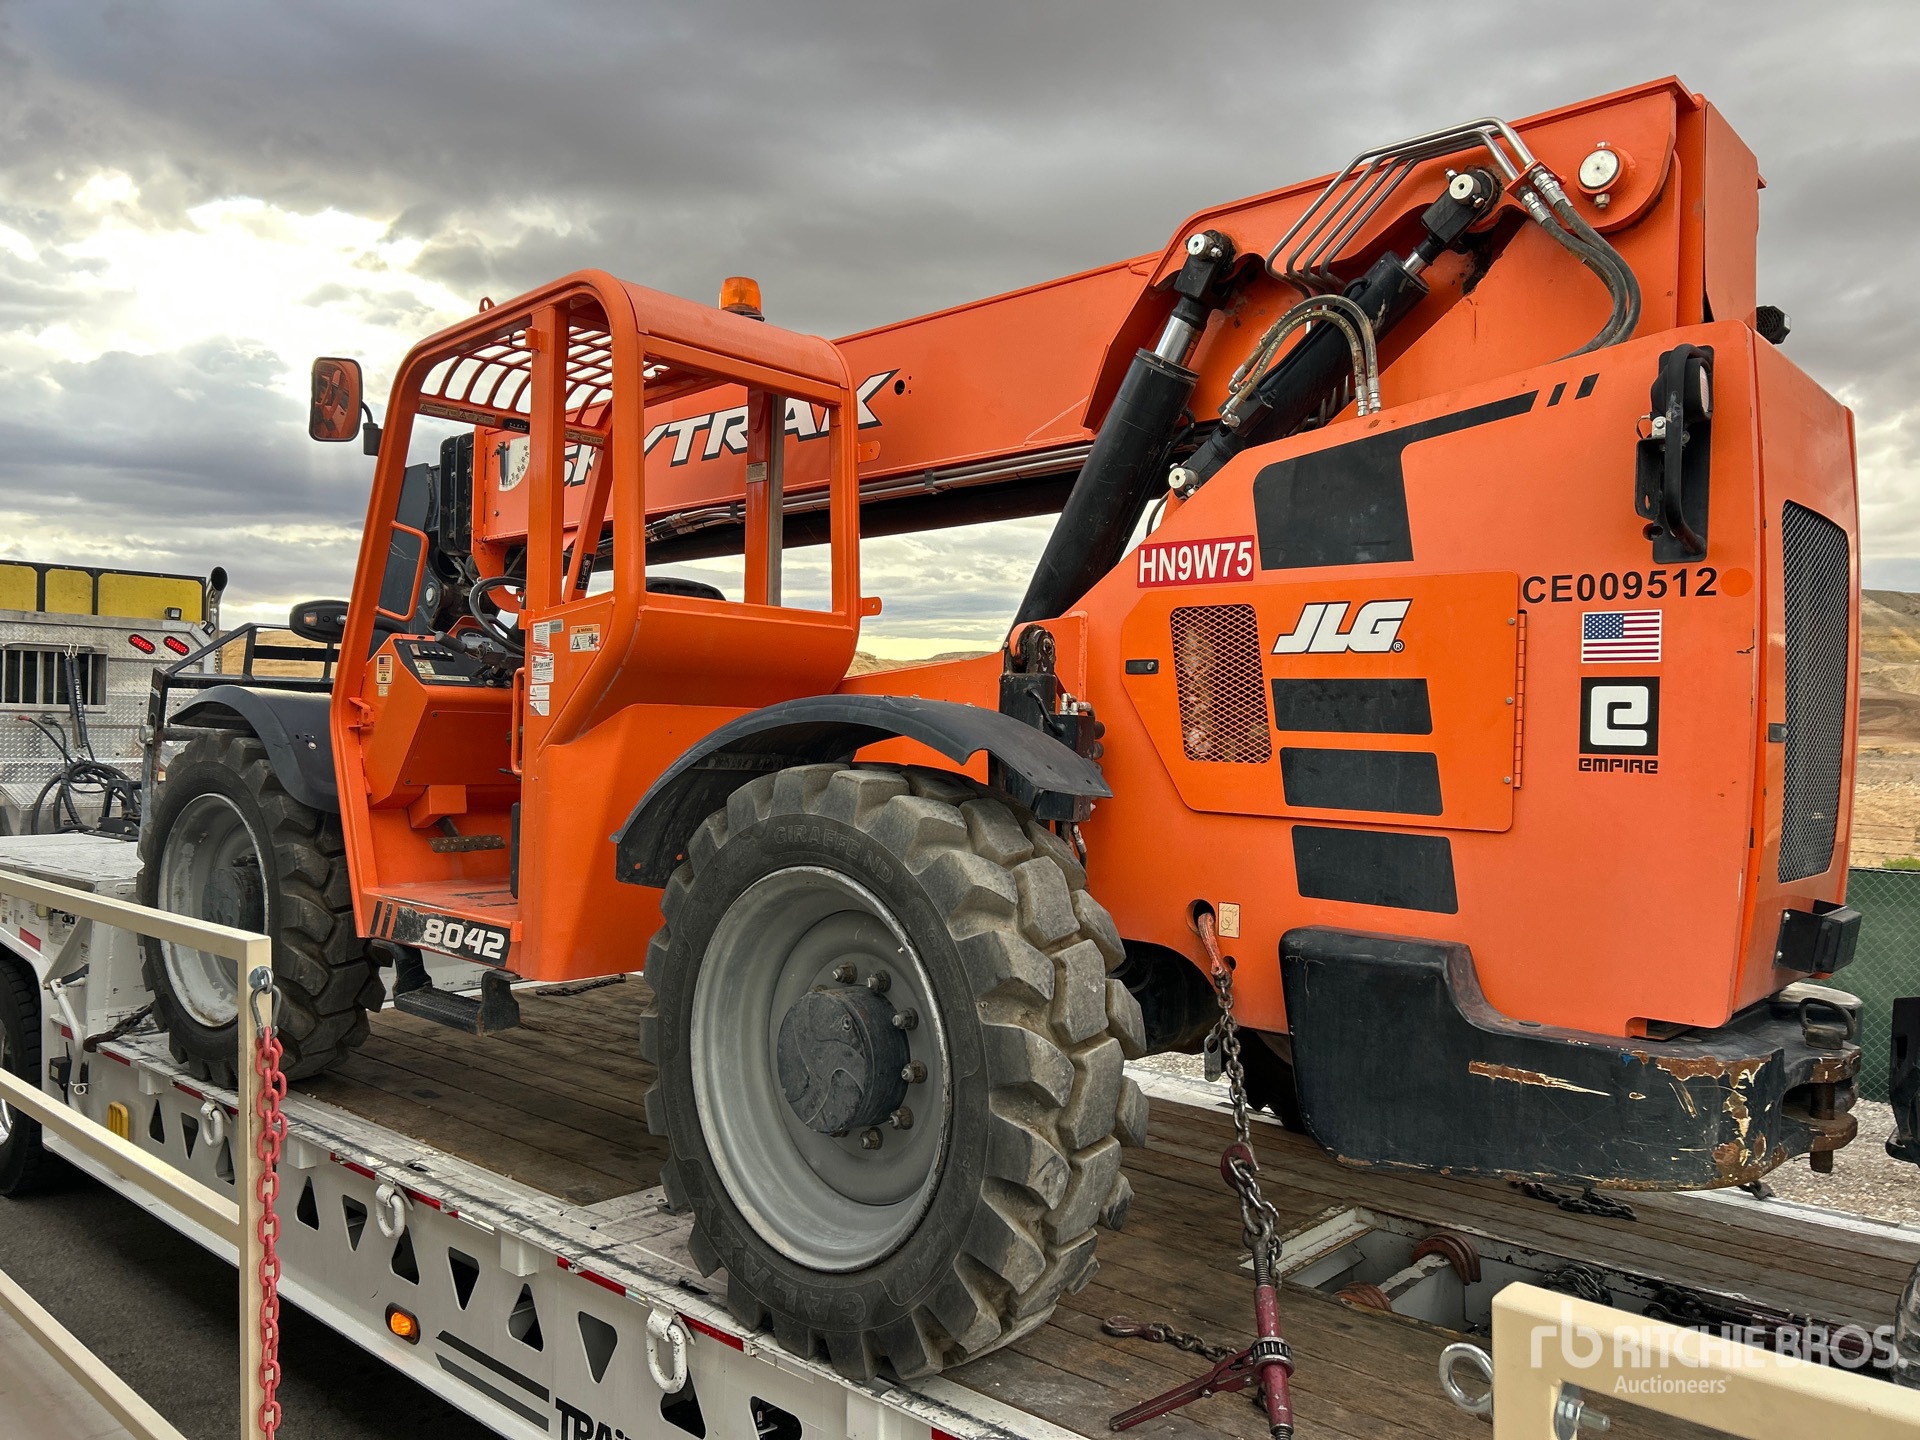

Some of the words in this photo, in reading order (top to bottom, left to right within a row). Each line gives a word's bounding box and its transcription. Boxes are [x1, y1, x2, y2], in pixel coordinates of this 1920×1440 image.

[564, 369, 901, 488] KTRAK
[1139, 541, 1252, 583] HN9W75
[1523, 567, 1717, 604] CE009512
[1271, 598, 1413, 655] JLG
[773, 824, 862, 860] GIRAFFE
[862, 849, 894, 883] ND
[424, 918, 505, 959] 8042
[689, 1194, 867, 1326] GALAXY
